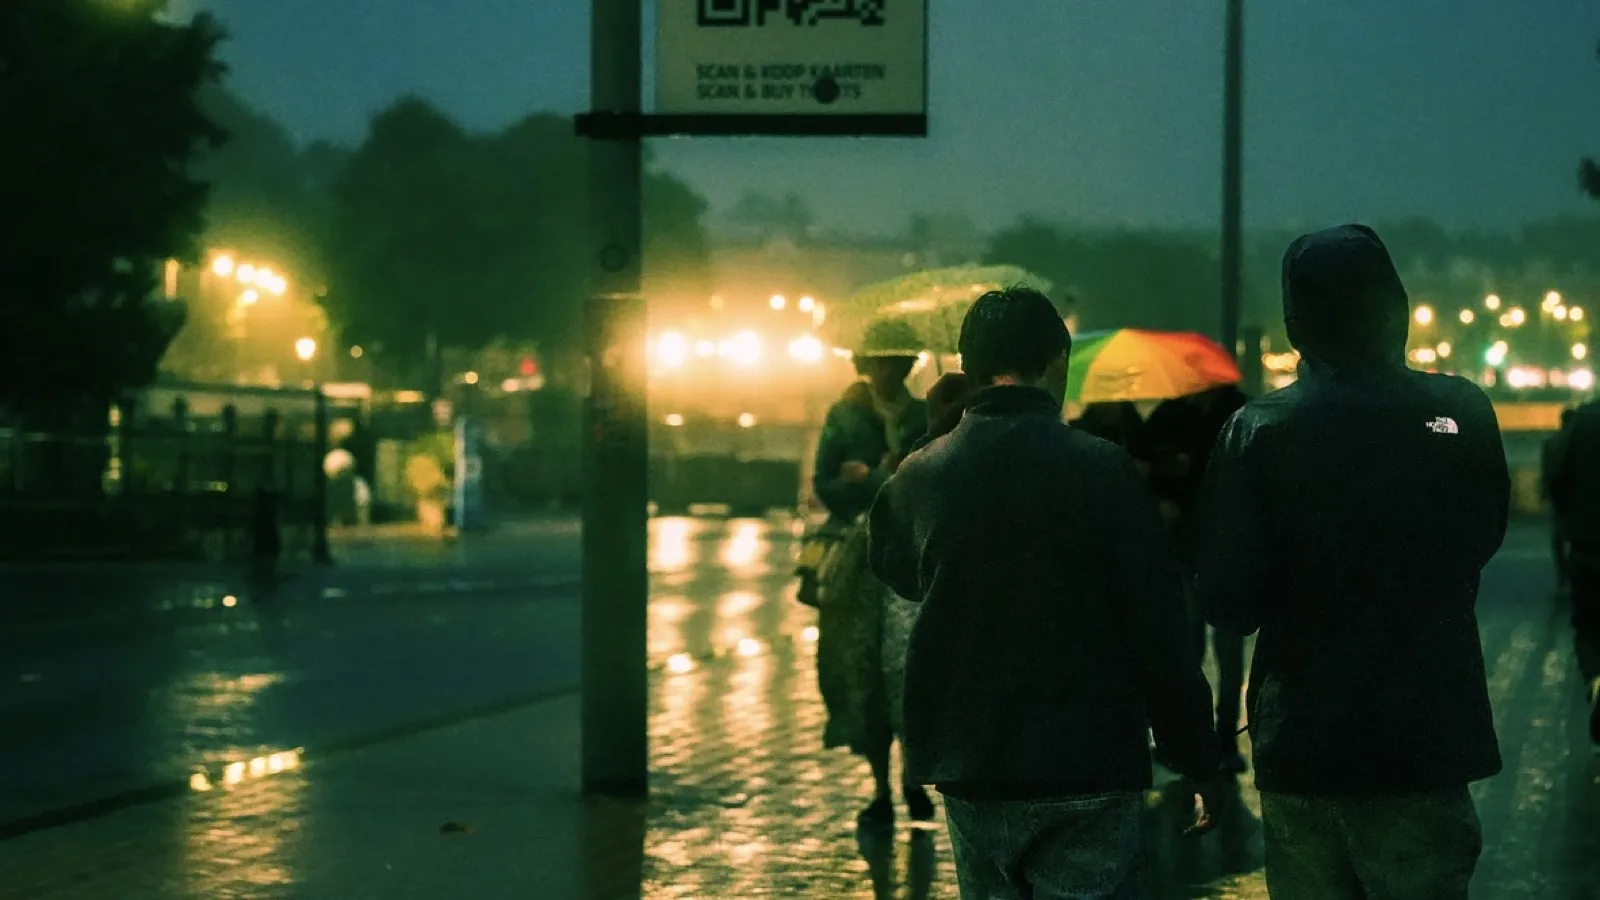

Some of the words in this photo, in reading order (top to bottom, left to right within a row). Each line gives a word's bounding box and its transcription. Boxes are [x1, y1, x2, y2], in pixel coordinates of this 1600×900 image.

[696, 64, 741, 79] SCAN
[743, 64, 758, 79] &
[761, 64, 806, 79] KOOP
[809, 64, 886, 79] KAARTEN
[696, 83, 740, 99] SCAN
[744, 83, 758, 99] &
[761, 83, 795, 99] BUY
